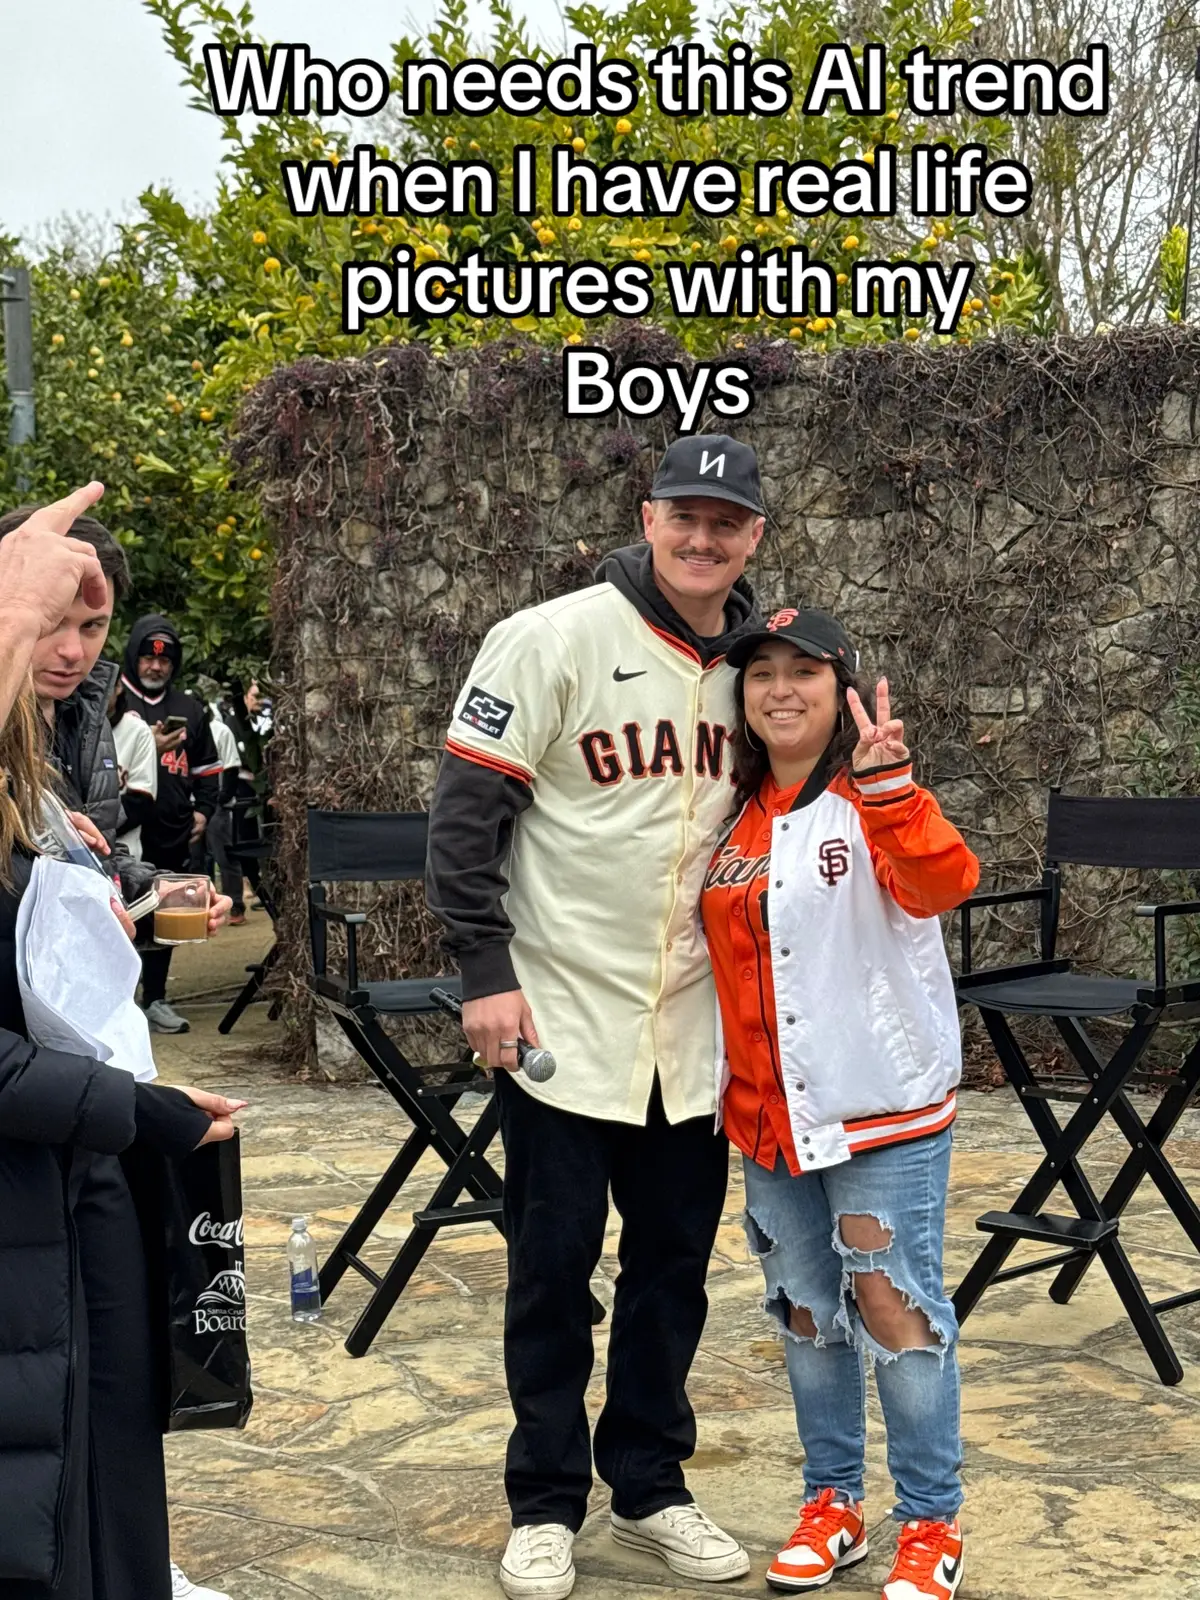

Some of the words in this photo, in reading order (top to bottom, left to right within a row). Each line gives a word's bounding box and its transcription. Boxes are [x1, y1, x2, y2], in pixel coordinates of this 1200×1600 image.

[766, 608, 799, 632] SF
[161, 749, 189, 777] 44
[578, 719, 739, 787] GIAN
[818, 837, 851, 887] SF
[207, 1307, 227, 1315] Santa
